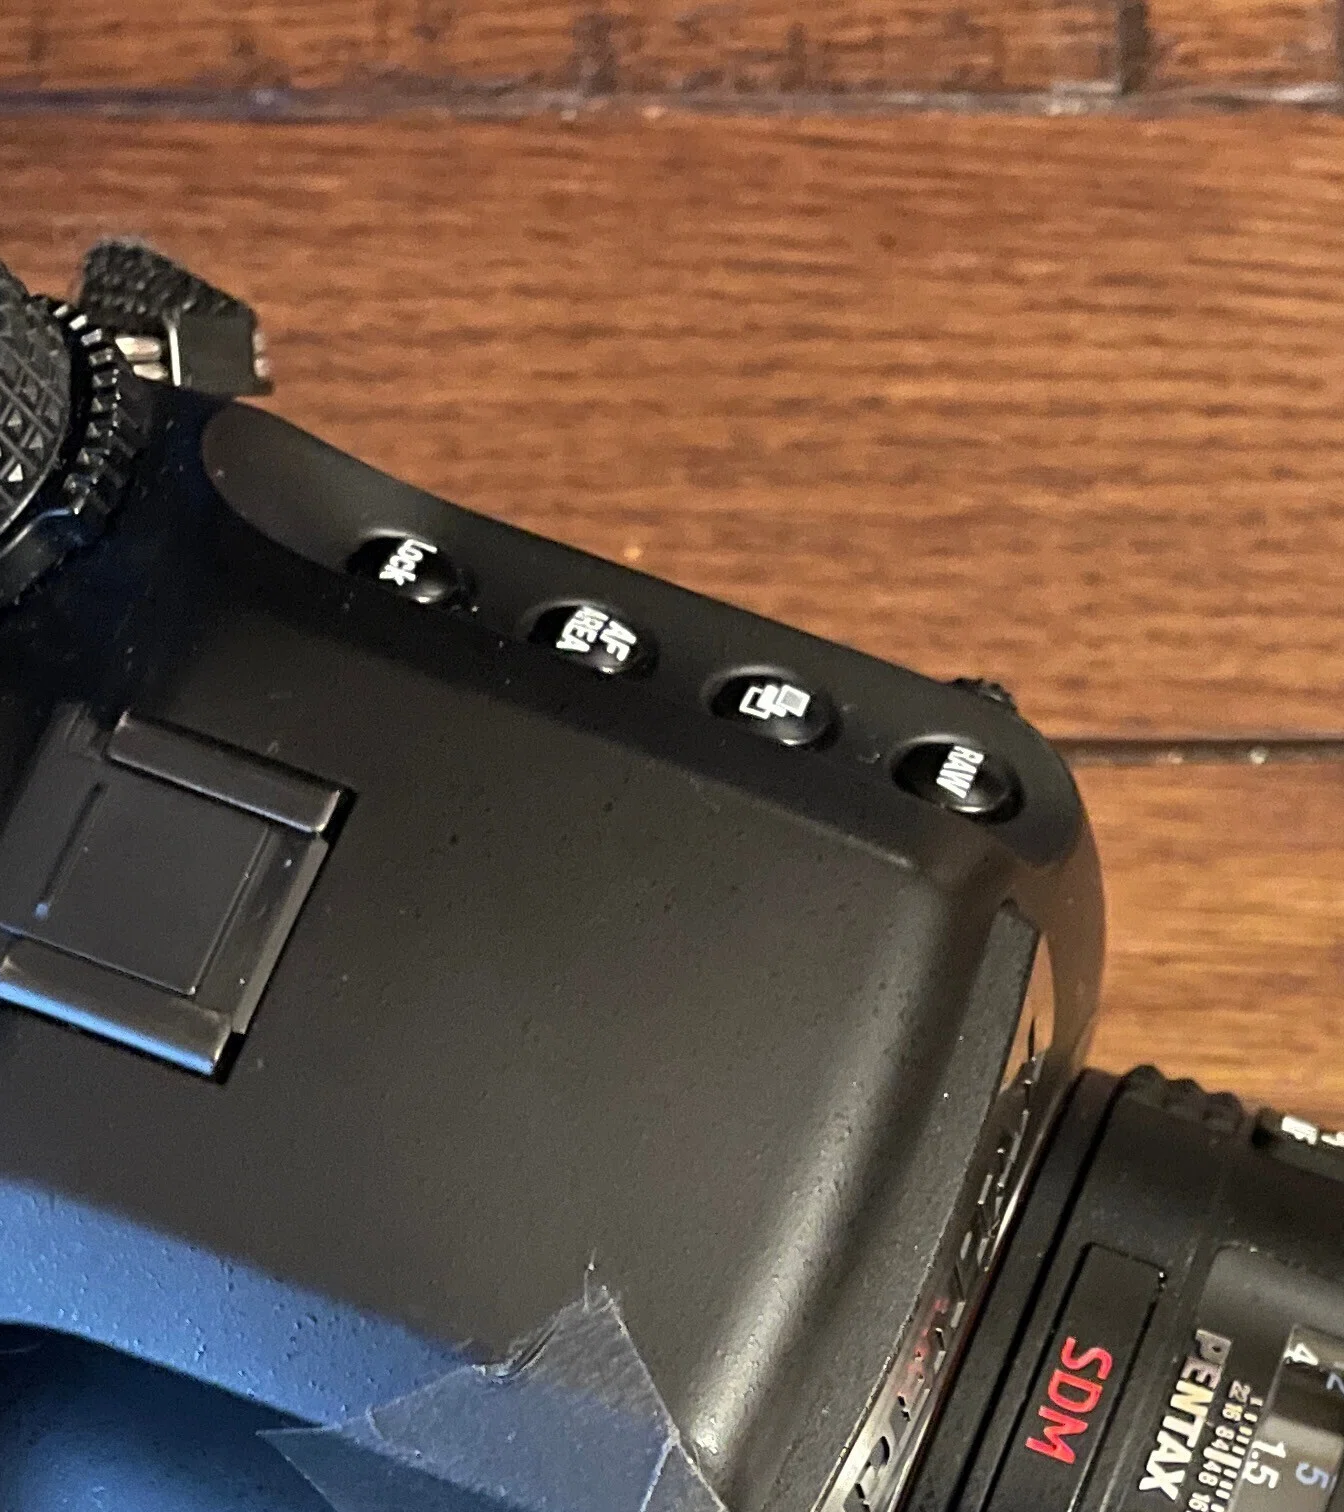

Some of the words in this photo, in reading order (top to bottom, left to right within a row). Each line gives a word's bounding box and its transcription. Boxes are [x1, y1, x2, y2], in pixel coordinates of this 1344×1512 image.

[378, 538, 438, 587] LOCK
[555, 605, 610, 654] AREA
[599, 619, 638, 662] AF
[935, 743, 985, 799] RAW
[1024, 1335, 1114, 1466] SDM
[1137, 1327, 1234, 1503] PENTAX
[1197, 1470, 1219, 1488] 8
[1241, 1440, 1288, 1490] 1.5
[1294, 1460, 1331, 1490] 5
